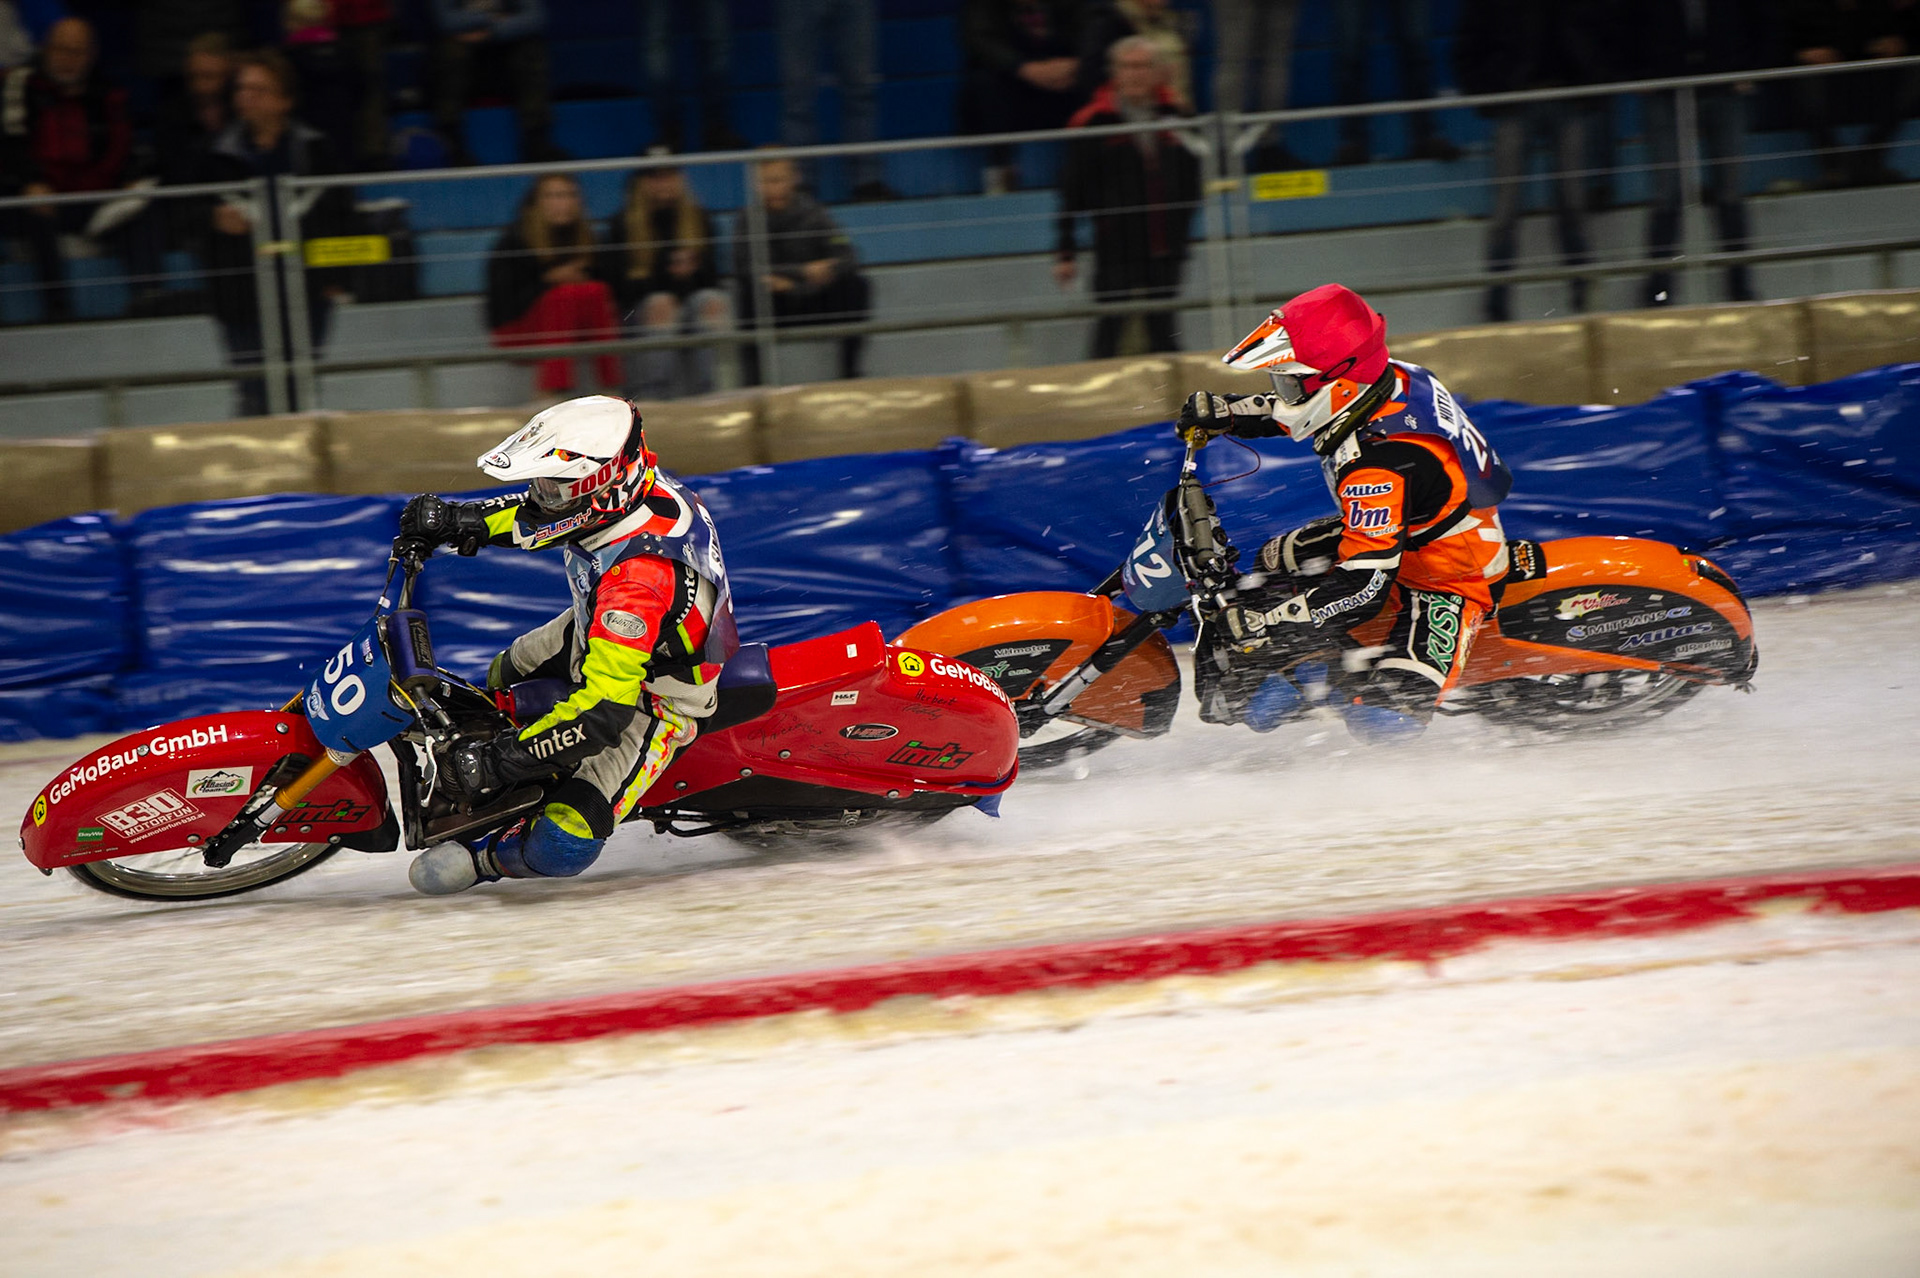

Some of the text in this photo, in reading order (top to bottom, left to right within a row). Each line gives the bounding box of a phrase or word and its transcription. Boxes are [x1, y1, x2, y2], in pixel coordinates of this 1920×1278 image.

[1341, 482, 1393, 498] Mitas
[535, 507, 591, 541] SUOMY
[1349, 500, 1392, 529] bm
[676, 565, 695, 624] winte
[1319, 569, 1387, 621] MITRANSCZ
[1618, 622, 1713, 650] Mitas
[324, 642, 366, 716] 50
[929, 658, 1007, 703] GeMoBau
[49, 724, 228, 805] GeMoBau GmbH
[124, 807, 193, 837] MOTORFUN
